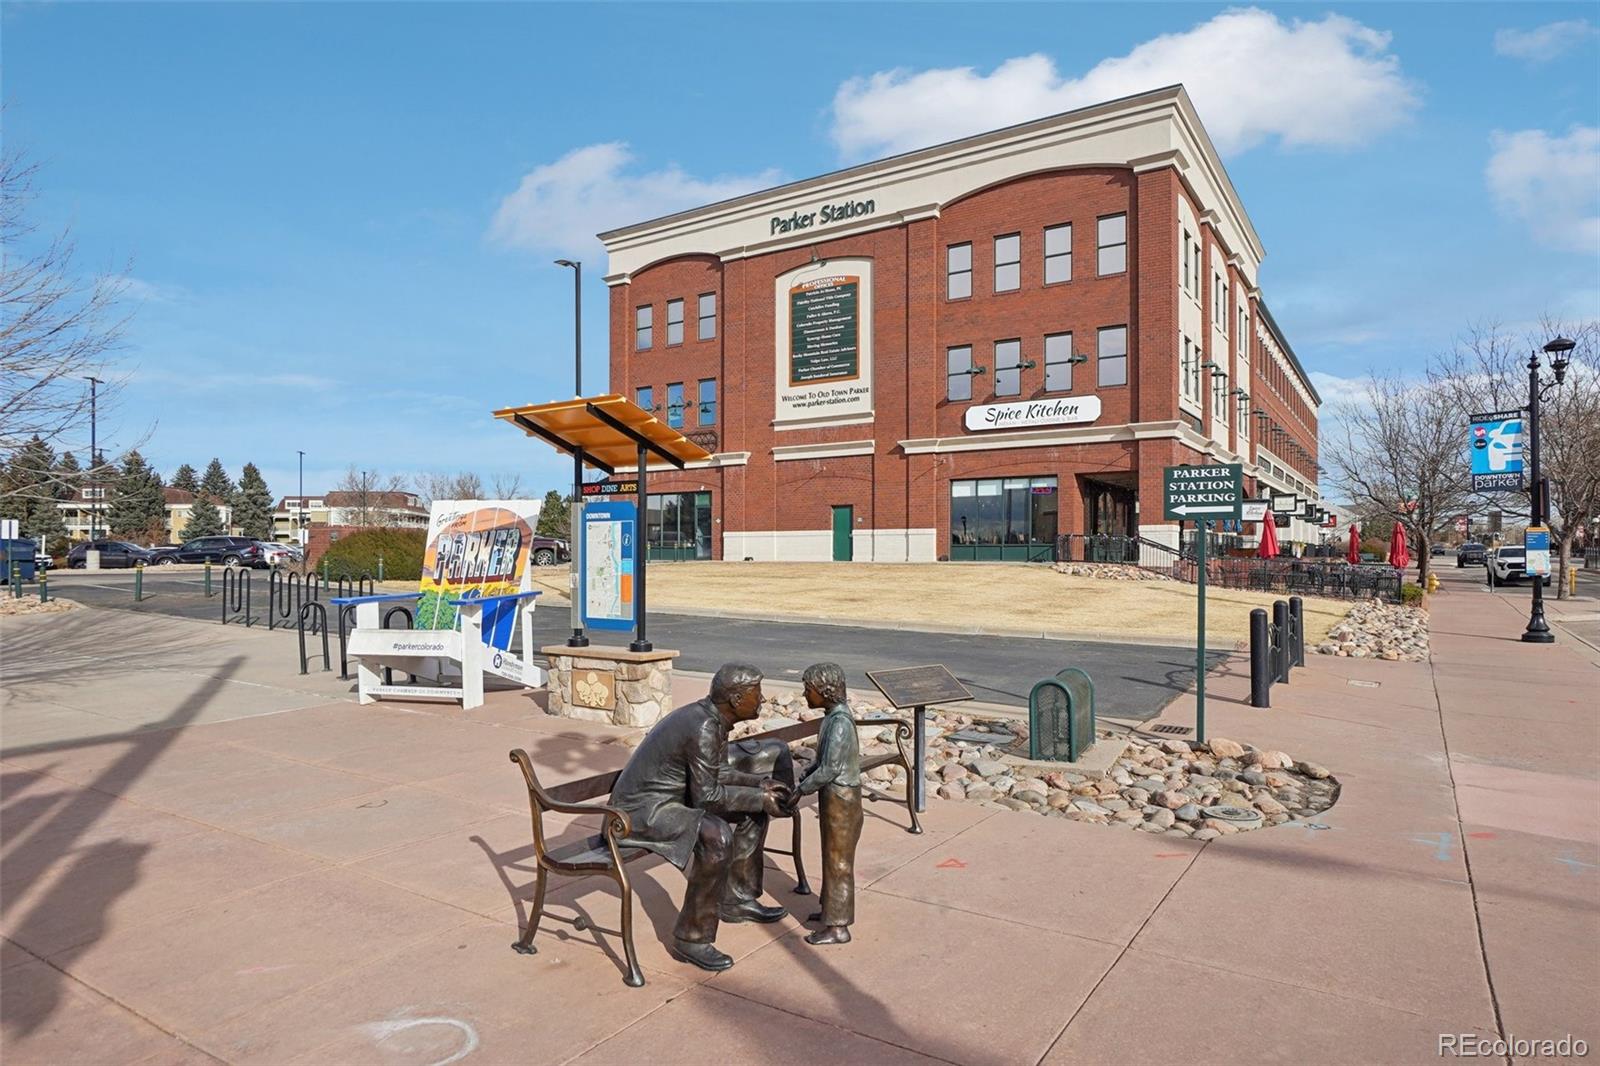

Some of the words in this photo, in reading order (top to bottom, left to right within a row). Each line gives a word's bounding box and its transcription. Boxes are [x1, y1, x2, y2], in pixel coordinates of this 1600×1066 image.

[770, 211, 816, 236] Parker
[819, 199, 875, 225] Station
[802, 276, 846, 289] PROFESSIONAL
[782, 394, 807, 402] WELCOME
[985, 407, 1021, 426] Spice
[1026, 400, 1080, 419] Kitchen
[1173, 468, 1230, 478] PARKER
[1474, 472, 1520, 480] DOWNTOWN
[584, 486, 600, 494] SHOP
[602, 484, 618, 492] DINE
[620, 484, 638, 492] ARTS
[1169, 480, 1235, 491] STATION
[1474, 478, 1519, 491] parker
[1169, 492, 1236, 504] PARKING
[433, 528, 522, 583] PARKER
[392, 642, 444, 652] #parkercolorado
